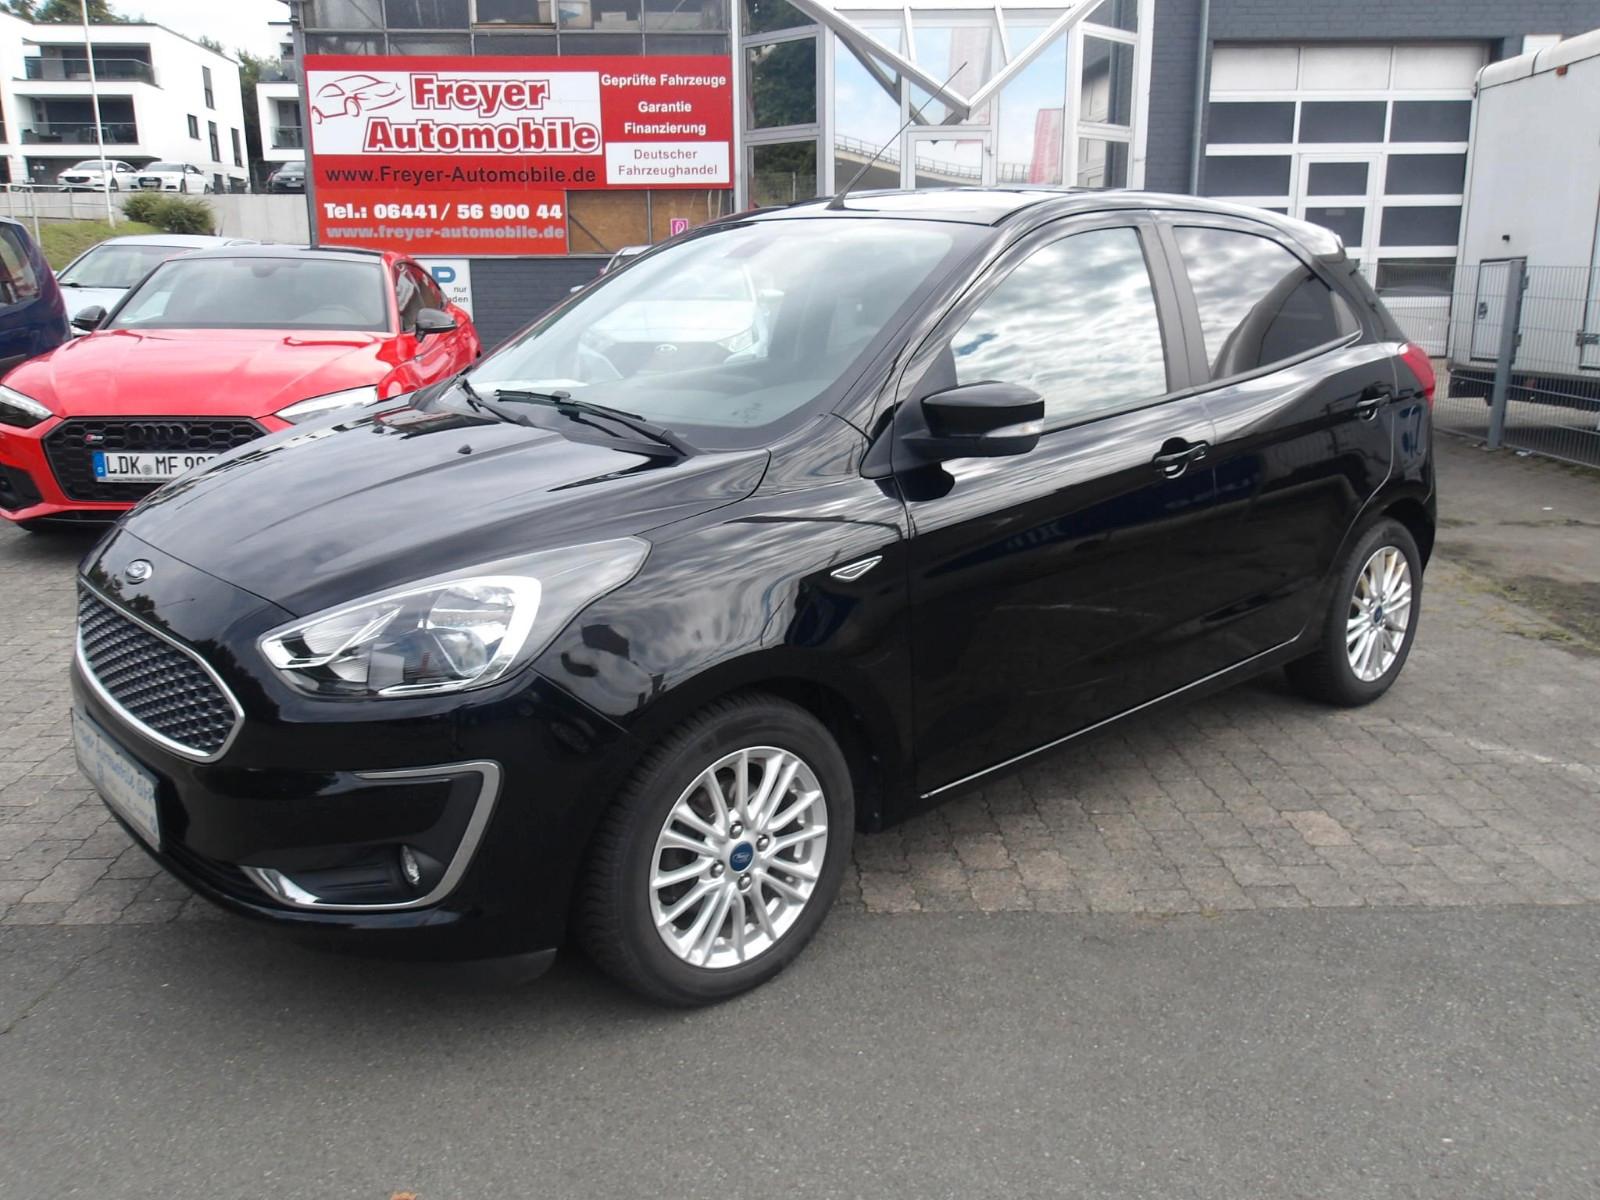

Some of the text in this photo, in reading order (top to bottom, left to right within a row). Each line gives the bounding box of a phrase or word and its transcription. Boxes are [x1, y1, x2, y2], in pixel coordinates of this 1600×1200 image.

[601, 74, 726, 88] Geprüfte Fahrzeuge
[410, 73, 550, 118] Freyer
[638, 101, 692, 112] Garantie
[362, 117, 600, 153] Automobile
[624, 122, 706, 136] Finanzierung
[634, 149, 698, 160] Deutscher
[325, 165, 596, 187] www.Freyer-Automobile.de
[618, 164, 718, 178] Fahrzeughandel
[323, 202, 368, 219] Tel.:
[456, 203, 484, 219] 56
[489, 203, 530, 219] 900
[536, 203, 563, 219] 44
[326, 225, 565, 241] www.freyer-automobile.de
[105, 455, 141, 475] LDK
[155, 455, 179, 475] MF
